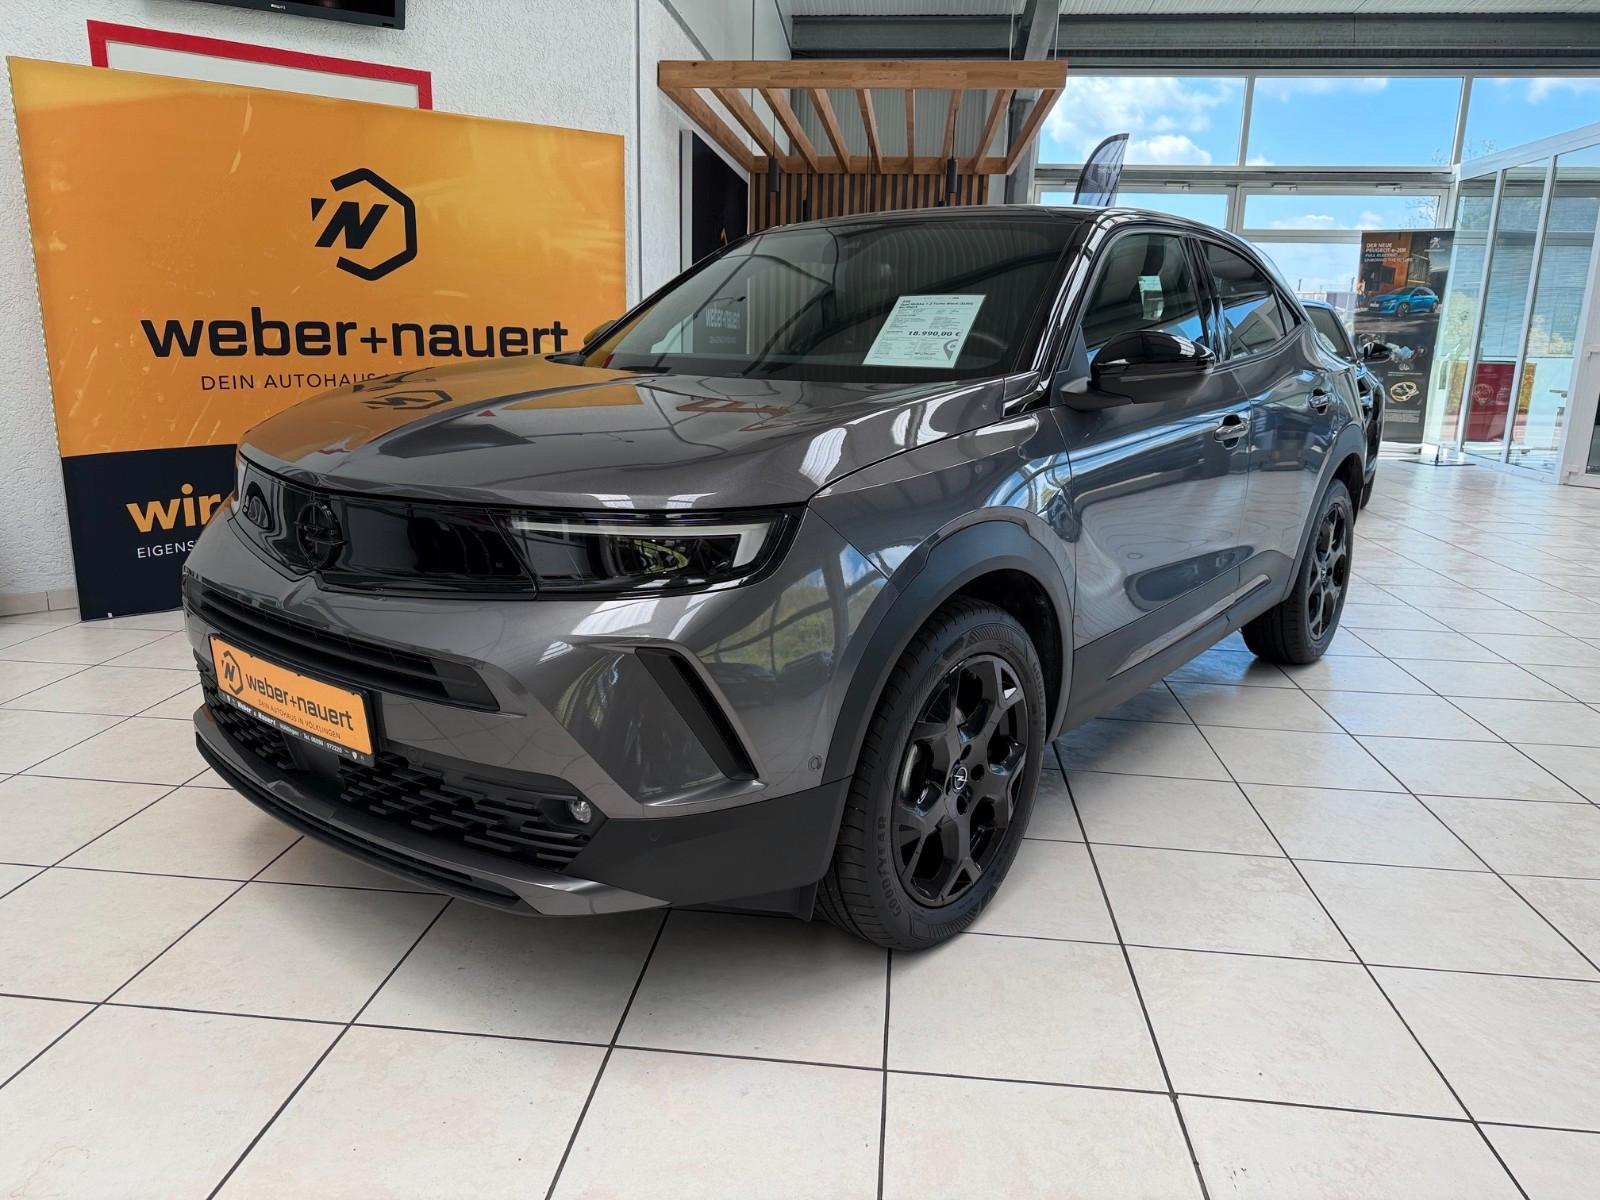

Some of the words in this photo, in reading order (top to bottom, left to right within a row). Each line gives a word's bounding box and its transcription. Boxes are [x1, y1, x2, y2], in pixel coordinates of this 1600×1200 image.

[140, 306, 568, 358] weber+nauert
[201, 374, 254, 391] DEIN
[126, 483, 222, 533] wir
[137, 540, 197, 559] EIGENS
[245, 673, 354, 732] weber+nauert
